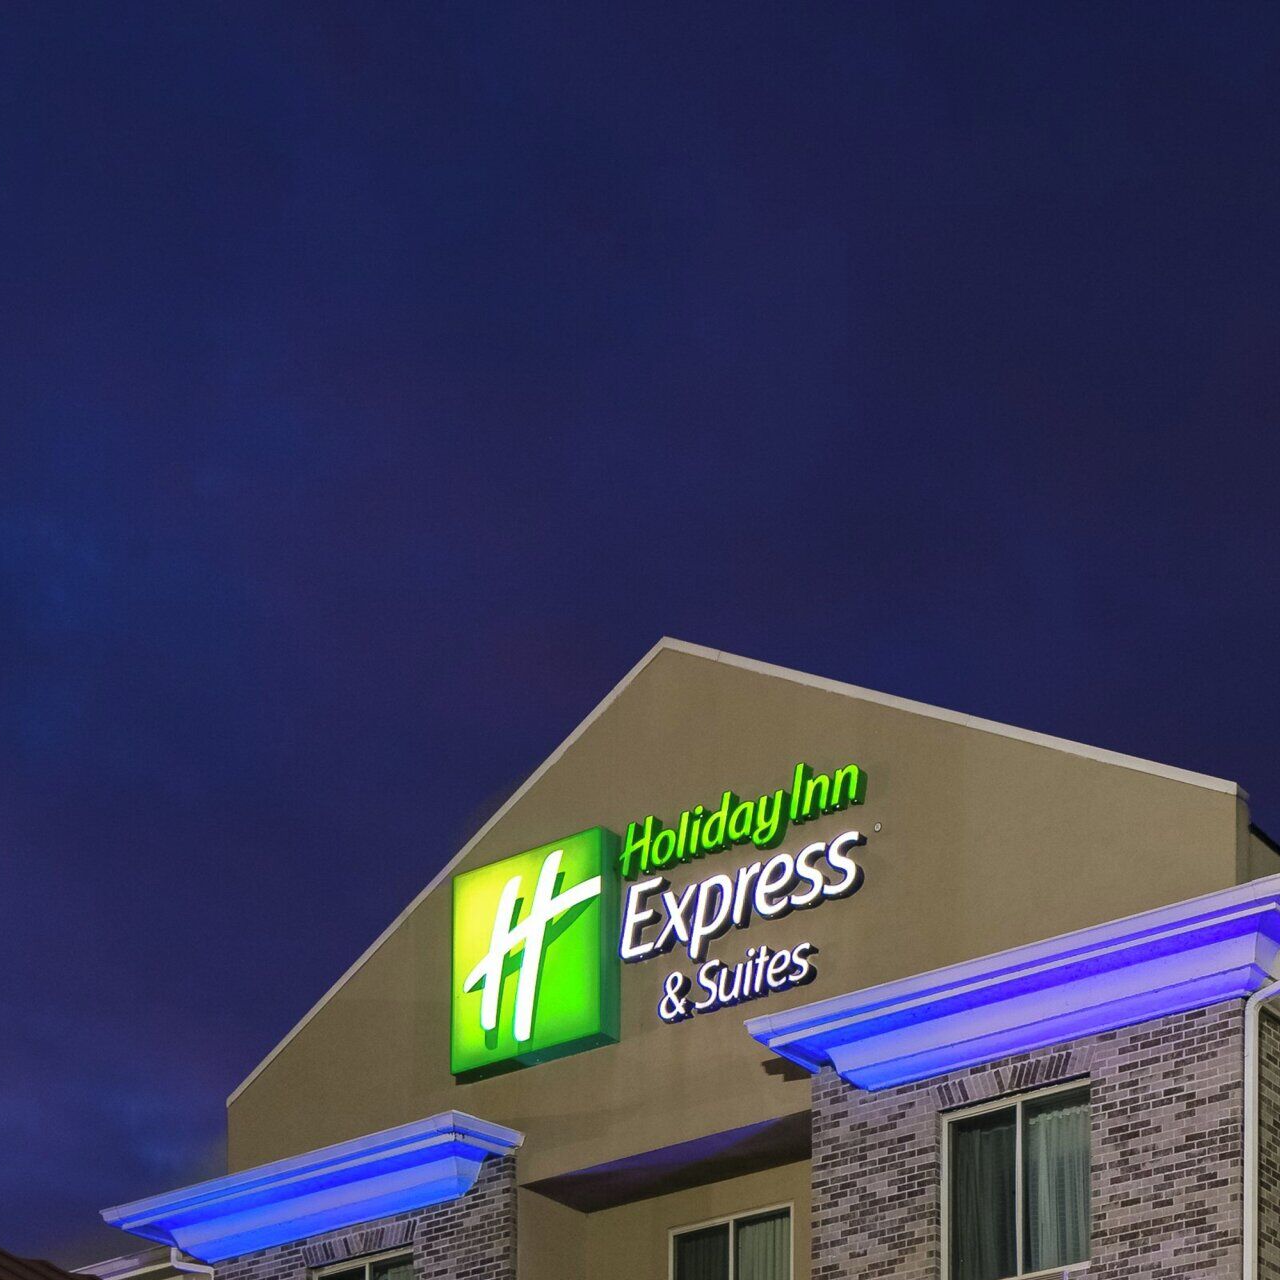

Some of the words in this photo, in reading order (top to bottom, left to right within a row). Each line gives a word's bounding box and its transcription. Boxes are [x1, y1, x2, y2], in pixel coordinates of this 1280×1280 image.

[621, 790, 784, 876] Holiday
[789, 762, 863, 820] Inn
[620, 831, 862, 962] Express
[657, 971, 690, 1022] &
[695, 942, 813, 1010] Suites
